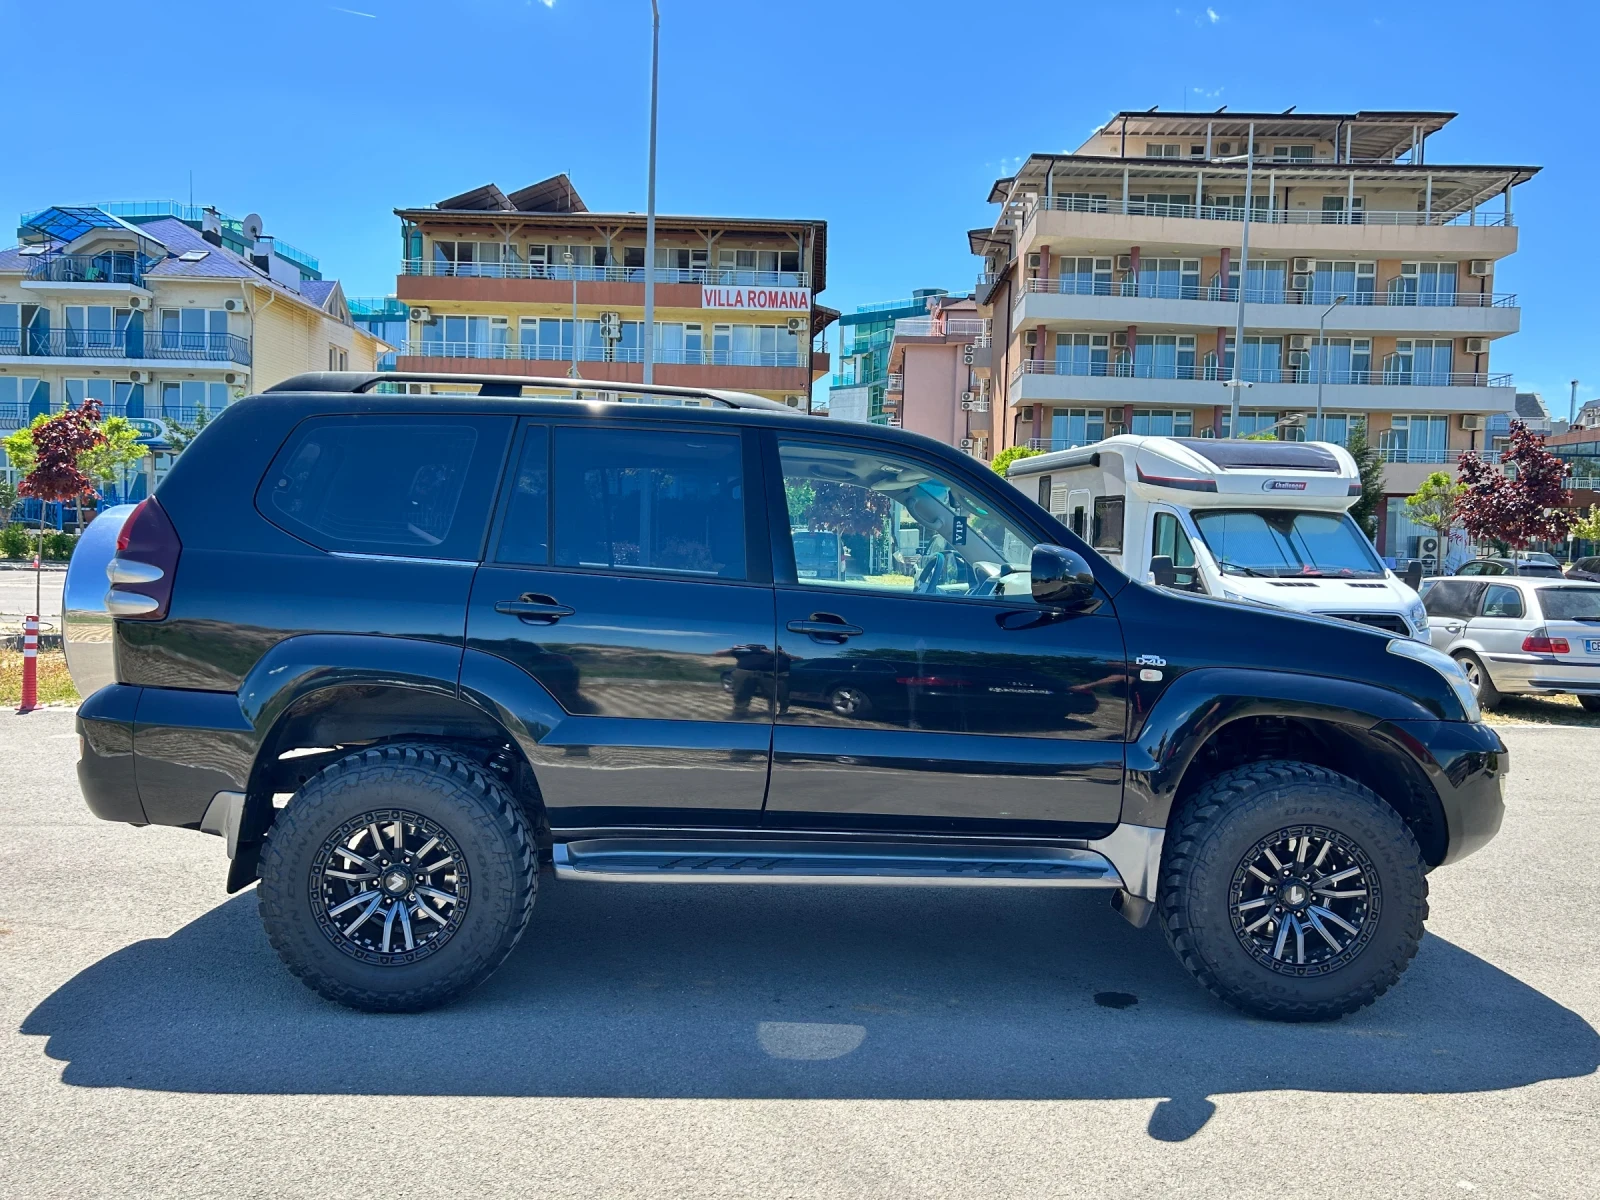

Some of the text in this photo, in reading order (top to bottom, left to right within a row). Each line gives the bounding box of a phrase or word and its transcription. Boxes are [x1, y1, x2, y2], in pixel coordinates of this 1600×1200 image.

[704, 289, 808, 309] VILLA ROMANA
[1275, 482, 1304, 490] Challenger
[956, 521, 964, 541] VIP
[1284, 806, 1344, 820] OPEN
